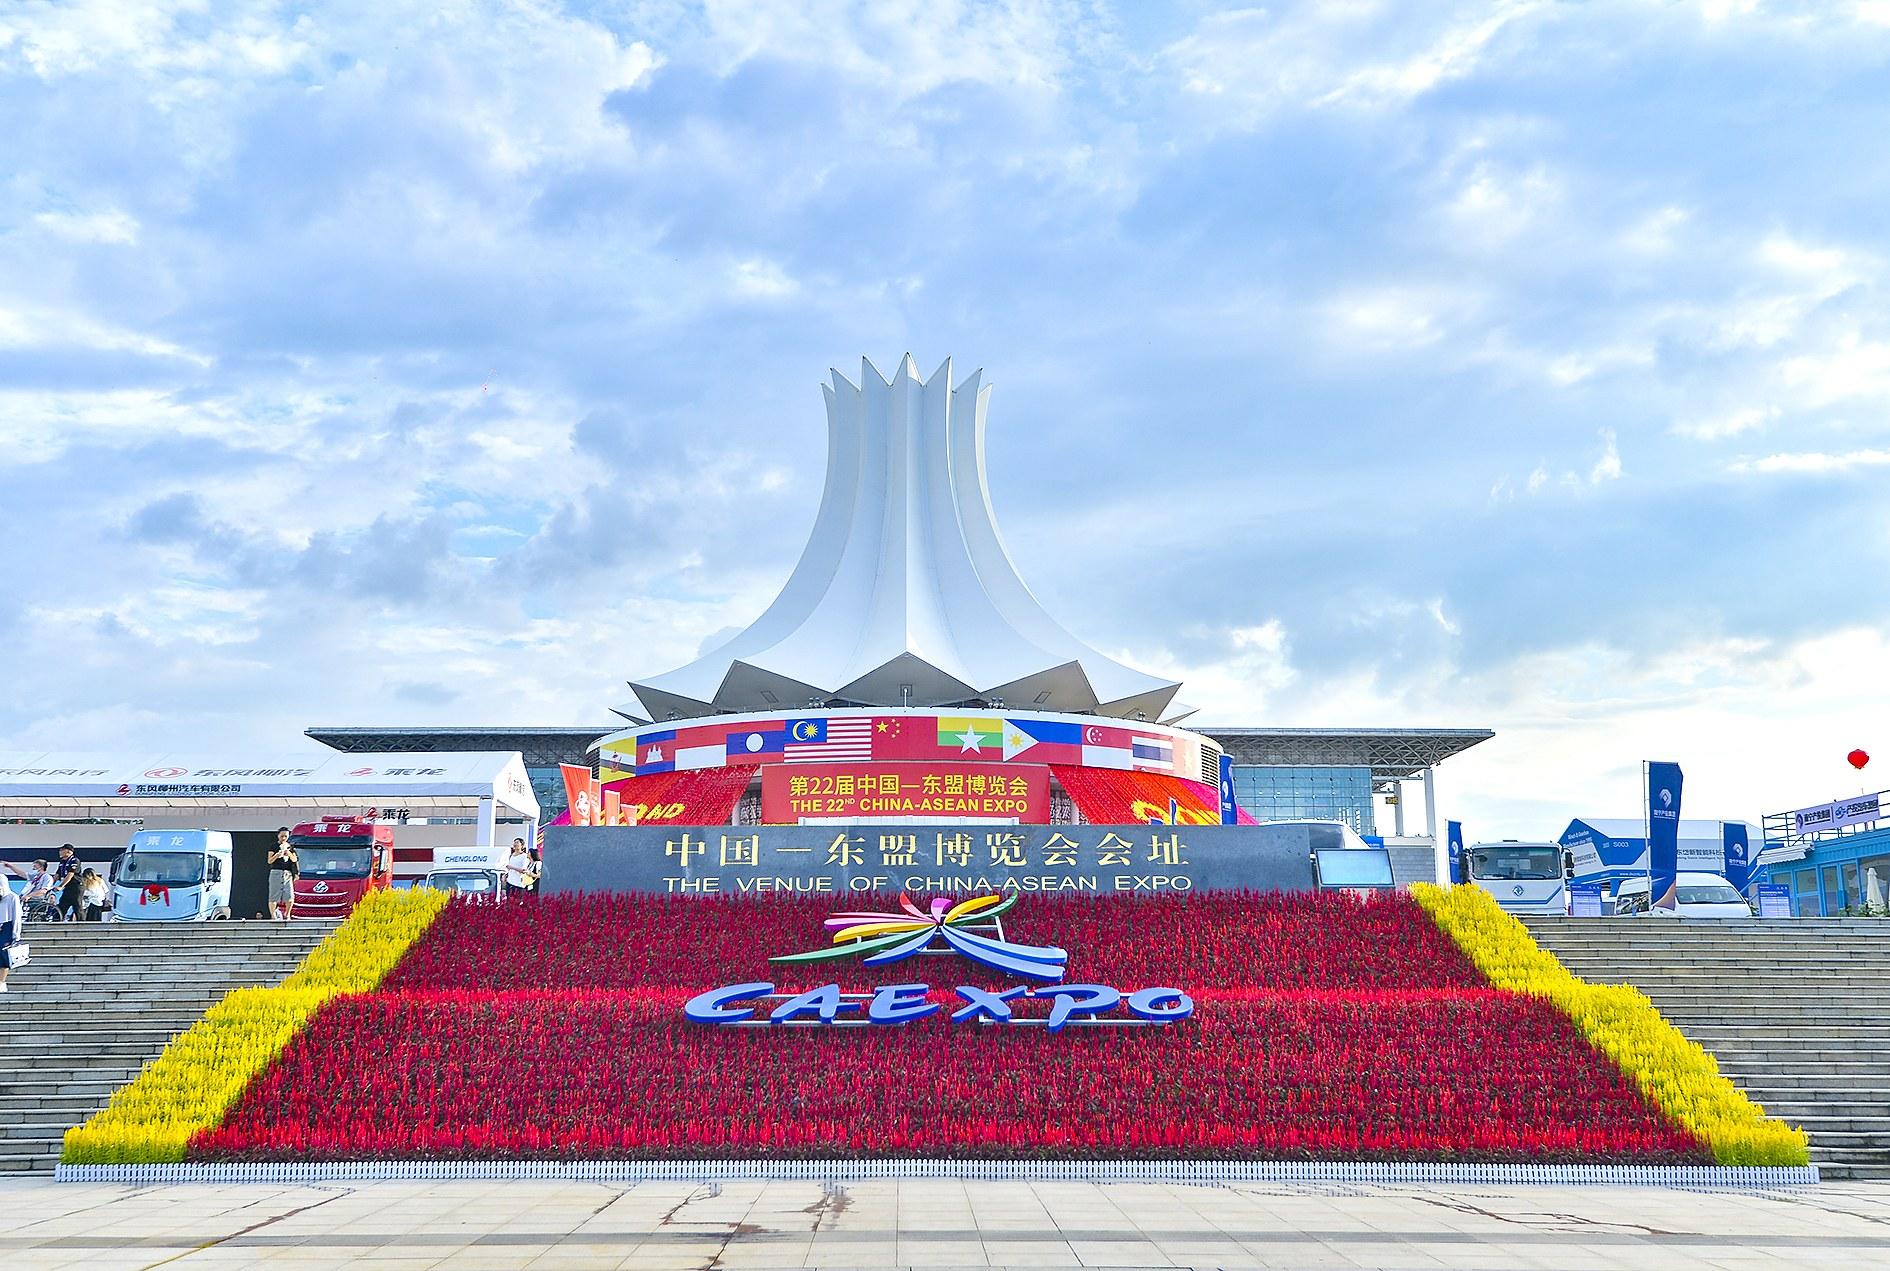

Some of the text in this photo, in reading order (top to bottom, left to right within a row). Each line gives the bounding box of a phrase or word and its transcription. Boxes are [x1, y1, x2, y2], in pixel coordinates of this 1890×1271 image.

[136, 784, 241, 793] 东风柳州汽车有限公司
[790, 799, 823, 813] THE
[860, 797, 979, 812] CHINA-ASEAN
[983, 799, 1028, 813] EXPO
[382, 807, 411, 821] 乘龙
[444, 854, 489, 863] CHENGLONG
[662, 875, 1192, 892] THE VENUE OF CHINA-ASEAN EXPO
[684, 981, 1194, 1034] CAEXPO
